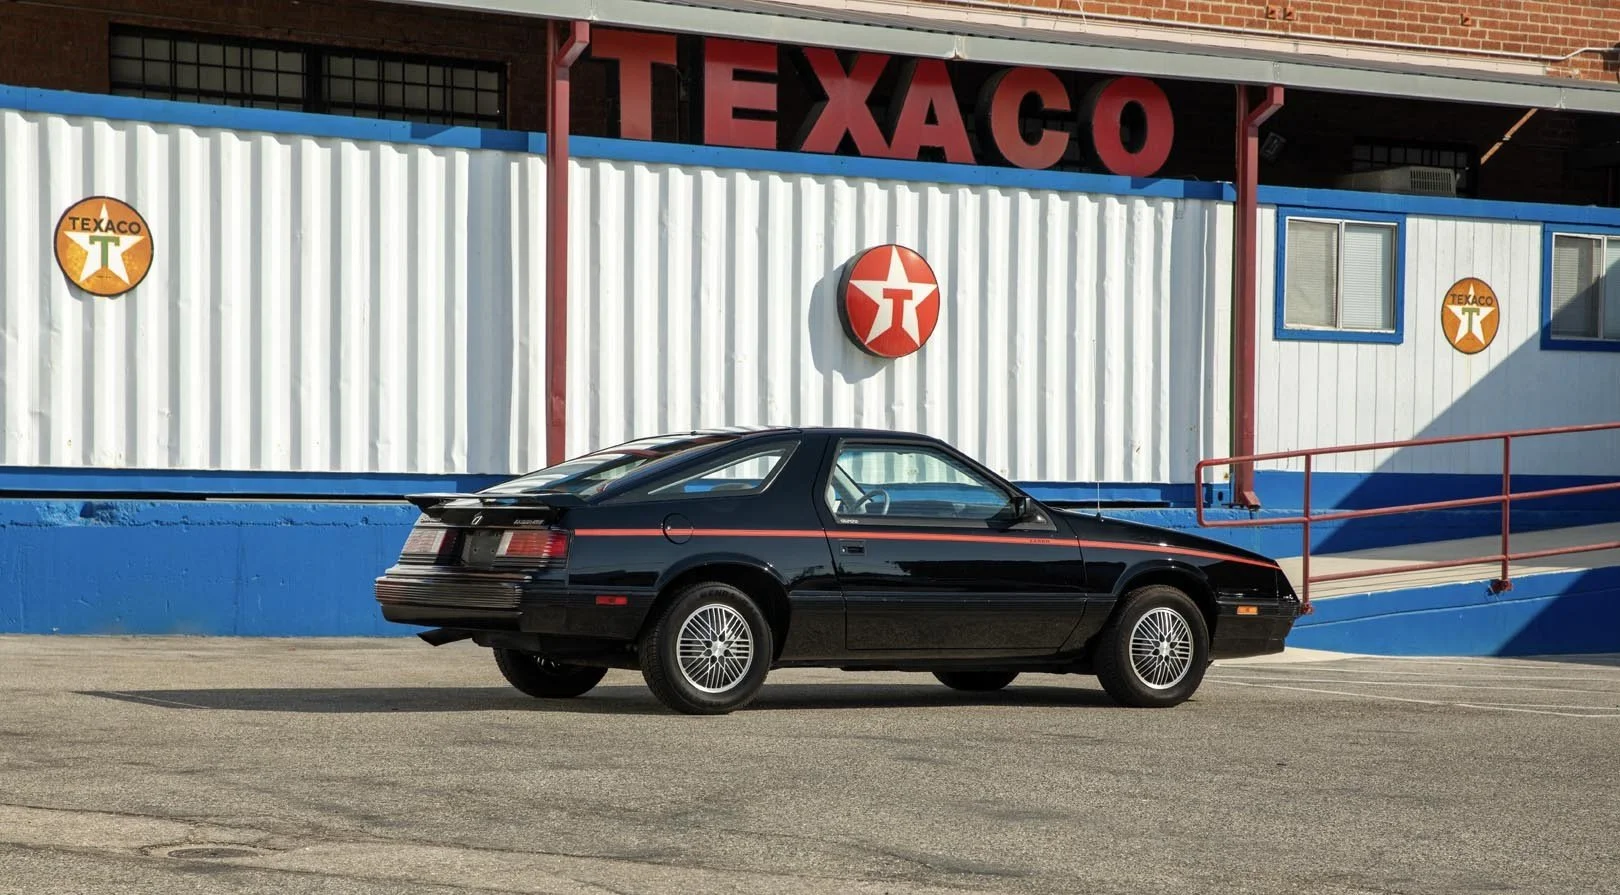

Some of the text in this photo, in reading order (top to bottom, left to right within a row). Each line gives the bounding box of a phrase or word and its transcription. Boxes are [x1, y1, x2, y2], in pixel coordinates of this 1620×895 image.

[591, 28, 1174, 178] TEXACO
[68, 216, 142, 234] TEXACO
[89, 235, 120, 268] T
[882, 288, 913, 329] T
[1450, 293, 1494, 307] TEXACO
[1462, 307, 1480, 332] T
